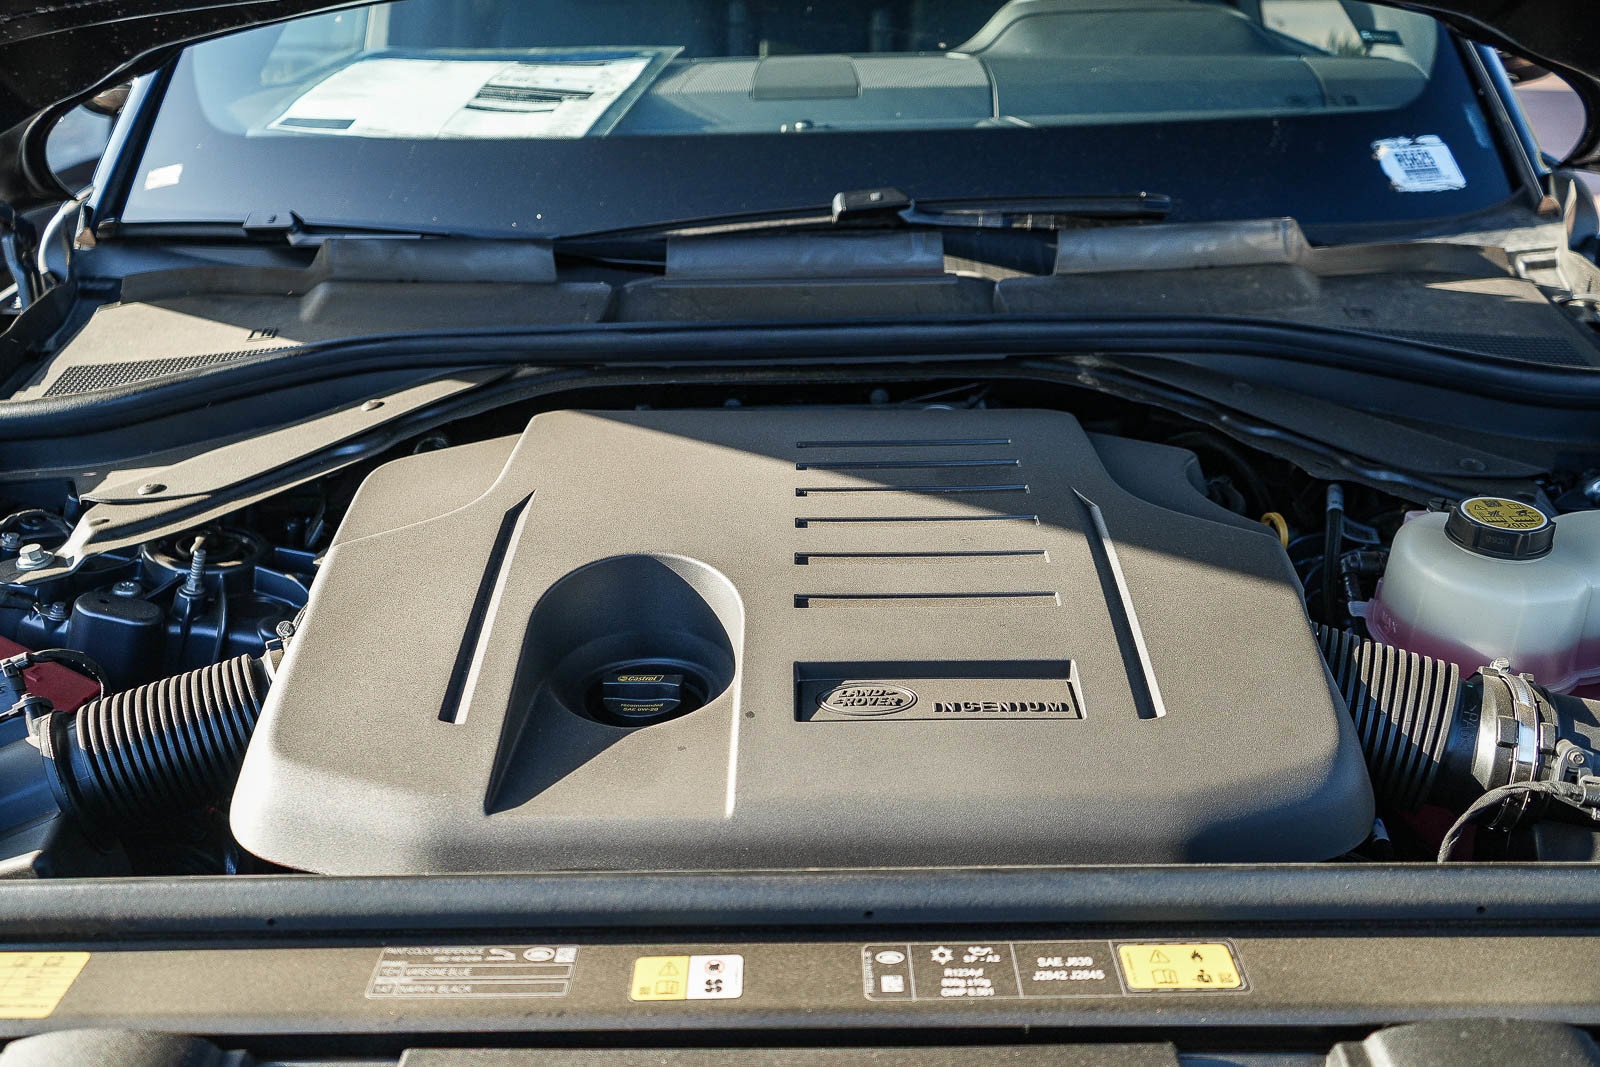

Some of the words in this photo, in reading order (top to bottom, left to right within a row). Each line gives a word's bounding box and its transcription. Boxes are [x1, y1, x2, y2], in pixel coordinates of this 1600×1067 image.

[839, 689, 886, 698] LAND
[842, 697, 904, 707] ROVER
[932, 701, 1071, 713] INGENIUM
[1037, 956, 1064, 967] SAE
